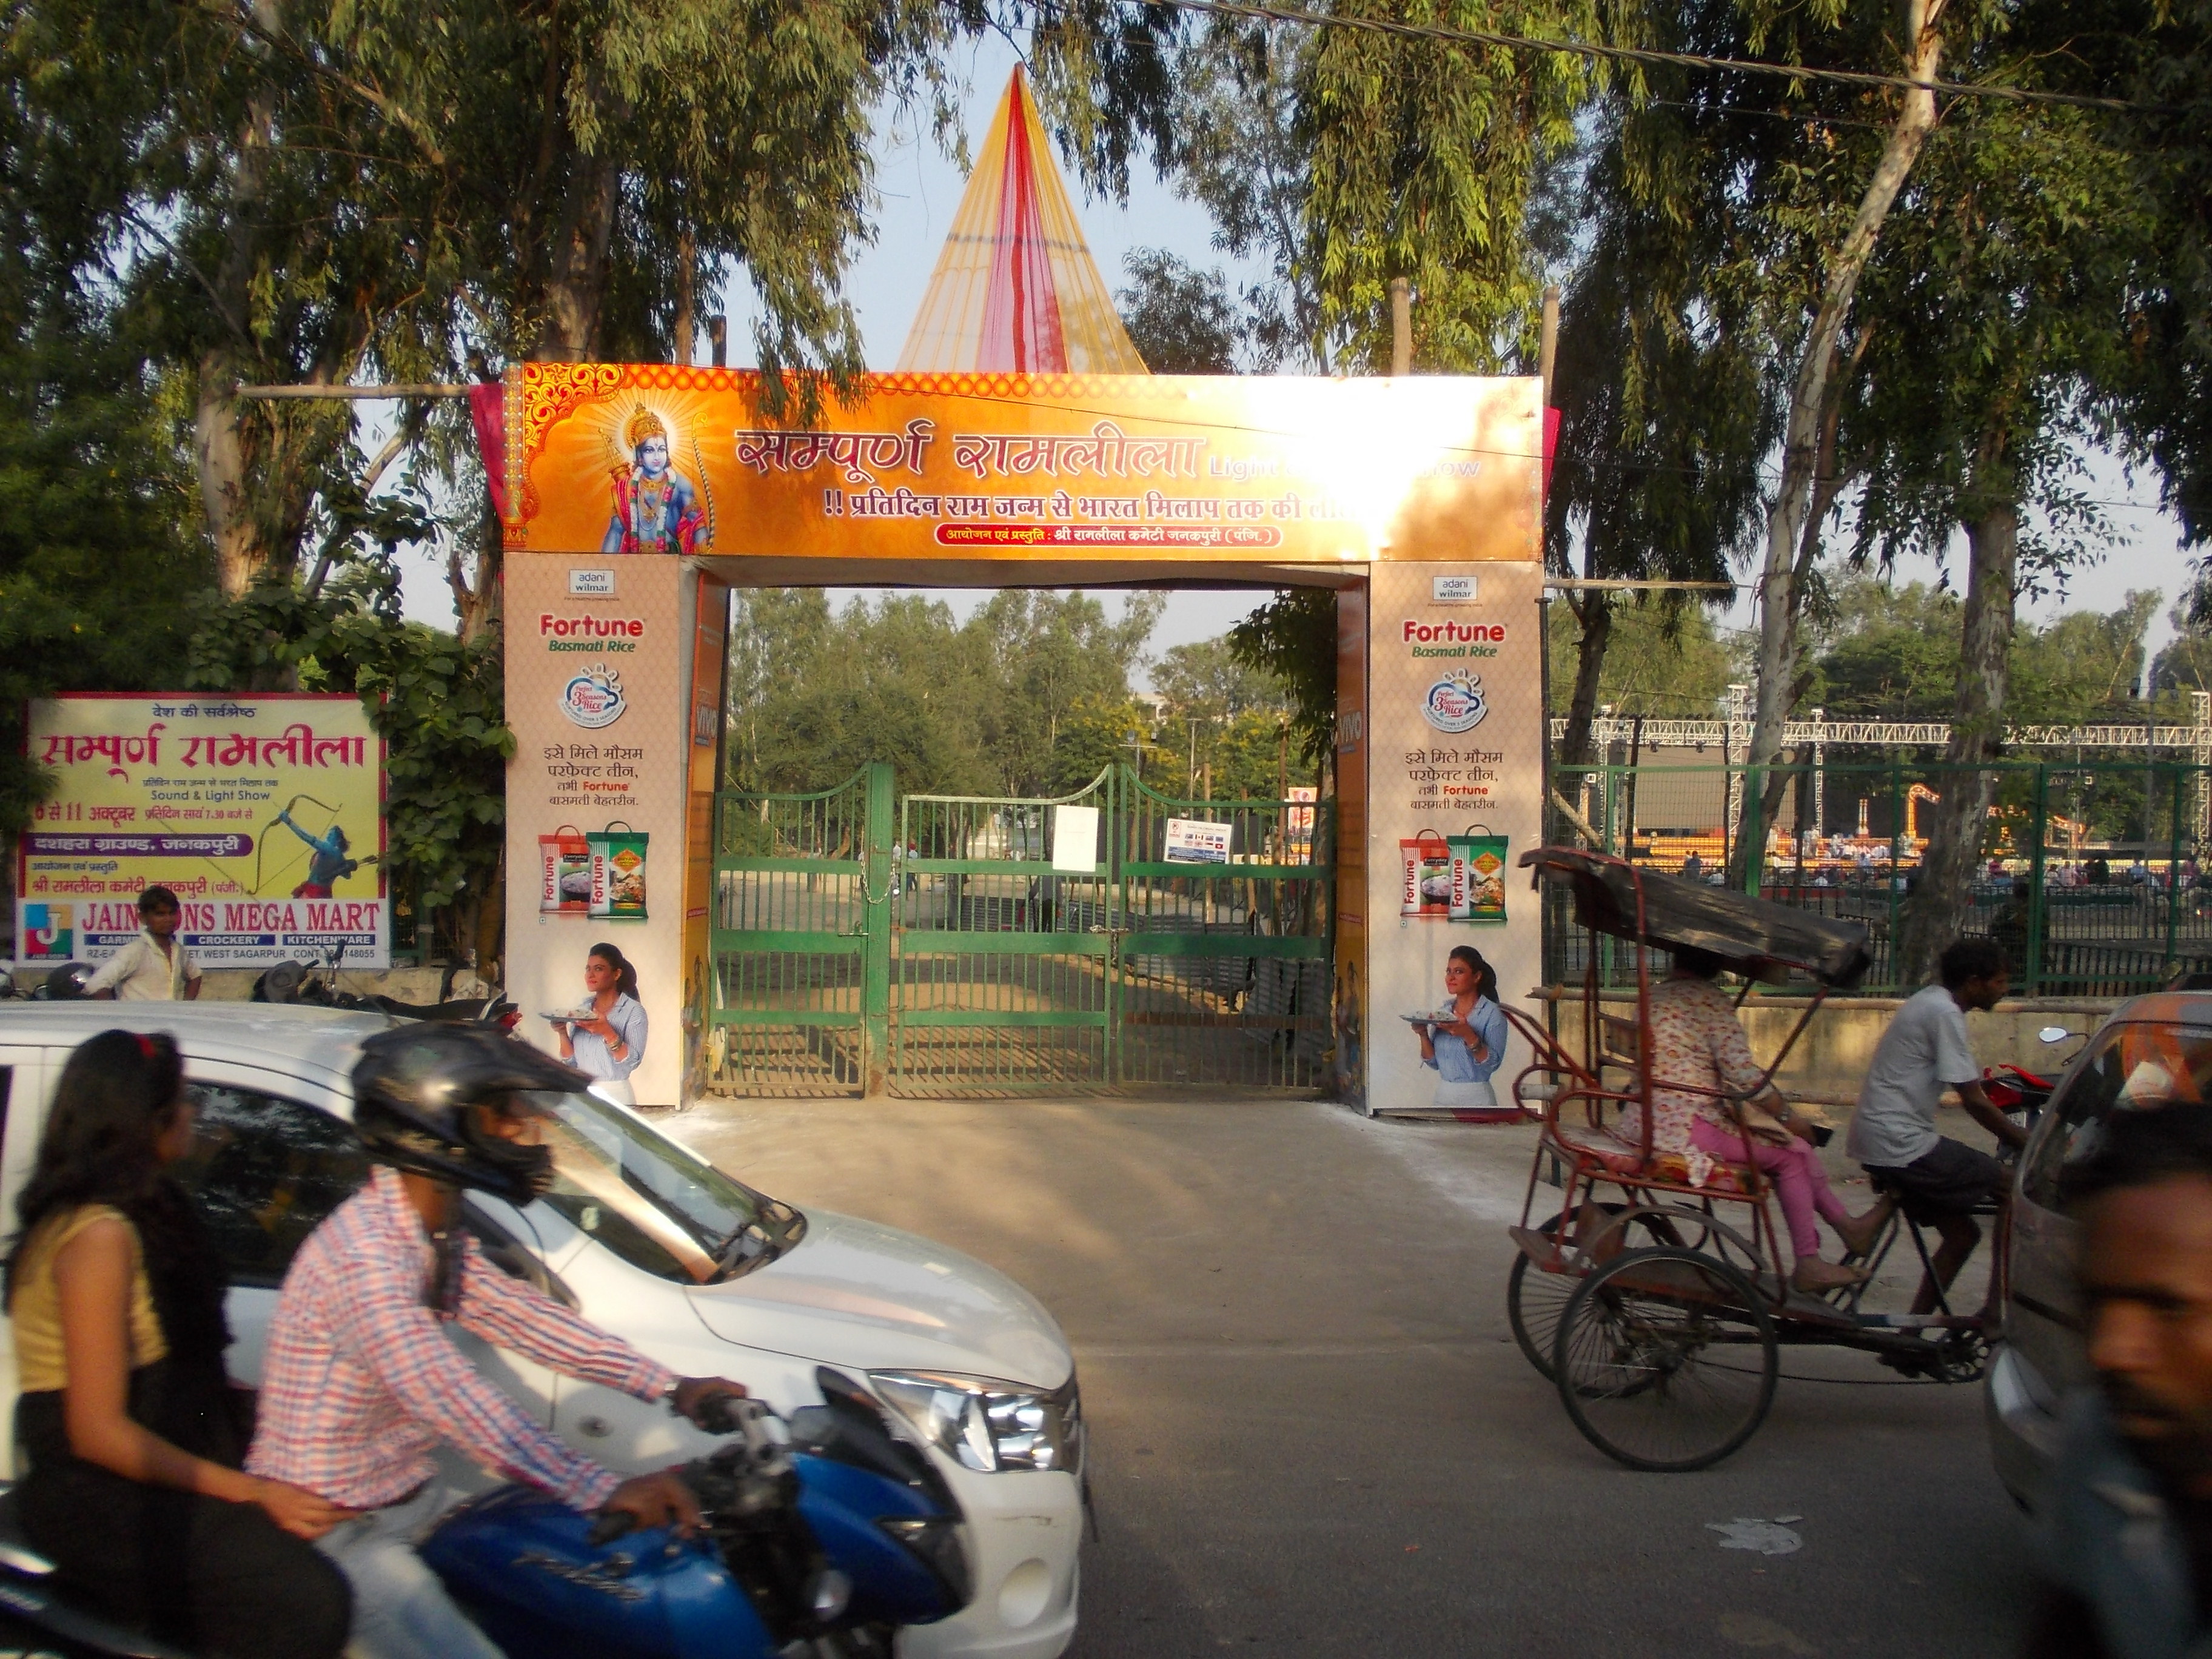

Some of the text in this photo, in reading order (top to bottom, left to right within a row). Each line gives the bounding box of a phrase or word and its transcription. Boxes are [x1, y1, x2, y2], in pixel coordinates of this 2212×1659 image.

[735, 418, 1207, 483] सम्पूर्ण रामलीला
[850, 487, 942, 517] प्रतिदिन
[946, 496, 990, 517] राम
[994, 497, 1046, 517] जन्म
[1051, 490, 1073, 517] से
[1079, 497, 1140, 518] भारत
[1145, 491, 1220, 518] मिलाप
[1225, 500, 1264, 518] तक
[1271, 492, 1302, 518] की
[946, 528, 992, 539] आयोजन
[995, 527, 1009, 541] एवं
[1011, 528, 1045, 543] प्रस्तुति
[1054, 526, 1071, 540] श्री
[1074, 526, 1125, 540] रामलीला
[1128, 527, 1164, 541] कमेटी
[1167, 527, 1221, 545] जनकपुरी
[579, 572, 605, 581] adani
[1443, 579, 1468, 588] adani
[540, 614, 644, 637] Fortune
[1403, 620, 1506, 643] Fortune
[549, 640, 635, 652] Basmati Rice
[1412, 646, 1497, 657] Basmati Rice
[152, 703, 175, 717] देश
[180, 703, 199, 717] की
[40, 722, 367, 783] सम्पूर्ण रामलीला
[544, 743, 643, 760] इसे मिले मौसम
[1405, 749, 1503, 765] इसे मिले मौसम
[557, 780, 629, 791] तभी Fortune
[1418, 783, 1488, 796] तभी Fortune
[151, 791, 270, 802] Sound & Light Show
[549, 794, 589, 806] बासमती
[1410, 799, 1450, 809] बासमती
[67, 802, 81, 820] 11
[35, 838, 90, 850] दशहरा
[161, 835, 240, 855] जनकपुरी
[32, 875, 48, 893] श्री
[52, 875, 105, 893] रामलीला
[109, 876, 146, 893] कमेटी
[544, 856, 555, 901] Fortune
[592, 855, 604, 905] Fortune
[1404, 859, 1415, 905] Fortune
[1452, 859, 1463, 908] Fortune
[224, 903, 298, 932] MEGA
[306, 903, 380, 932] MART
[198, 936, 260, 944] CROCKERY
[233, 950, 286, 958] SAGARPUR
